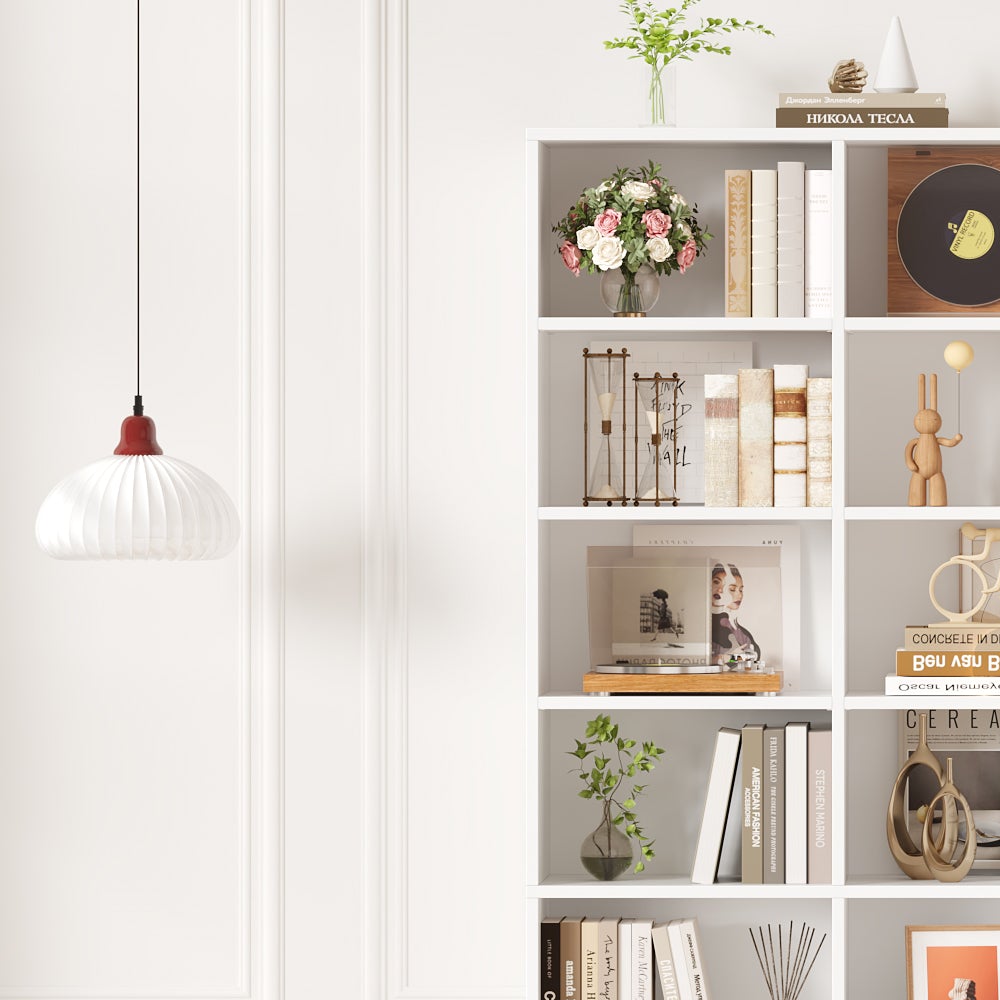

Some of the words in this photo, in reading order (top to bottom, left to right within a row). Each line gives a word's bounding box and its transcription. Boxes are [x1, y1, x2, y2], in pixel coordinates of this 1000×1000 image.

[785, 96, 822, 105] Джордан
[823, 96, 866, 105] Элленберг
[806, 113, 864, 124] НИКОЛА
[867, 113, 915, 124] ТЕСЛА
[770, 736, 778, 757] FRIDA
[770, 759, 778, 783] KAHLO
[751, 767, 761, 810] AMERICAN
[815, 769, 825, 813] STEPHEN
[751, 812, 761, 848] FASHION
[815, 814, 825, 848] MARINO
[603, 934, 614, 954] The
[638, 936, 648, 959] Karen
[565, 960, 577, 997] amanda
[586, 949, 596, 988] Arianna
[693, 974, 702, 993] Метод
